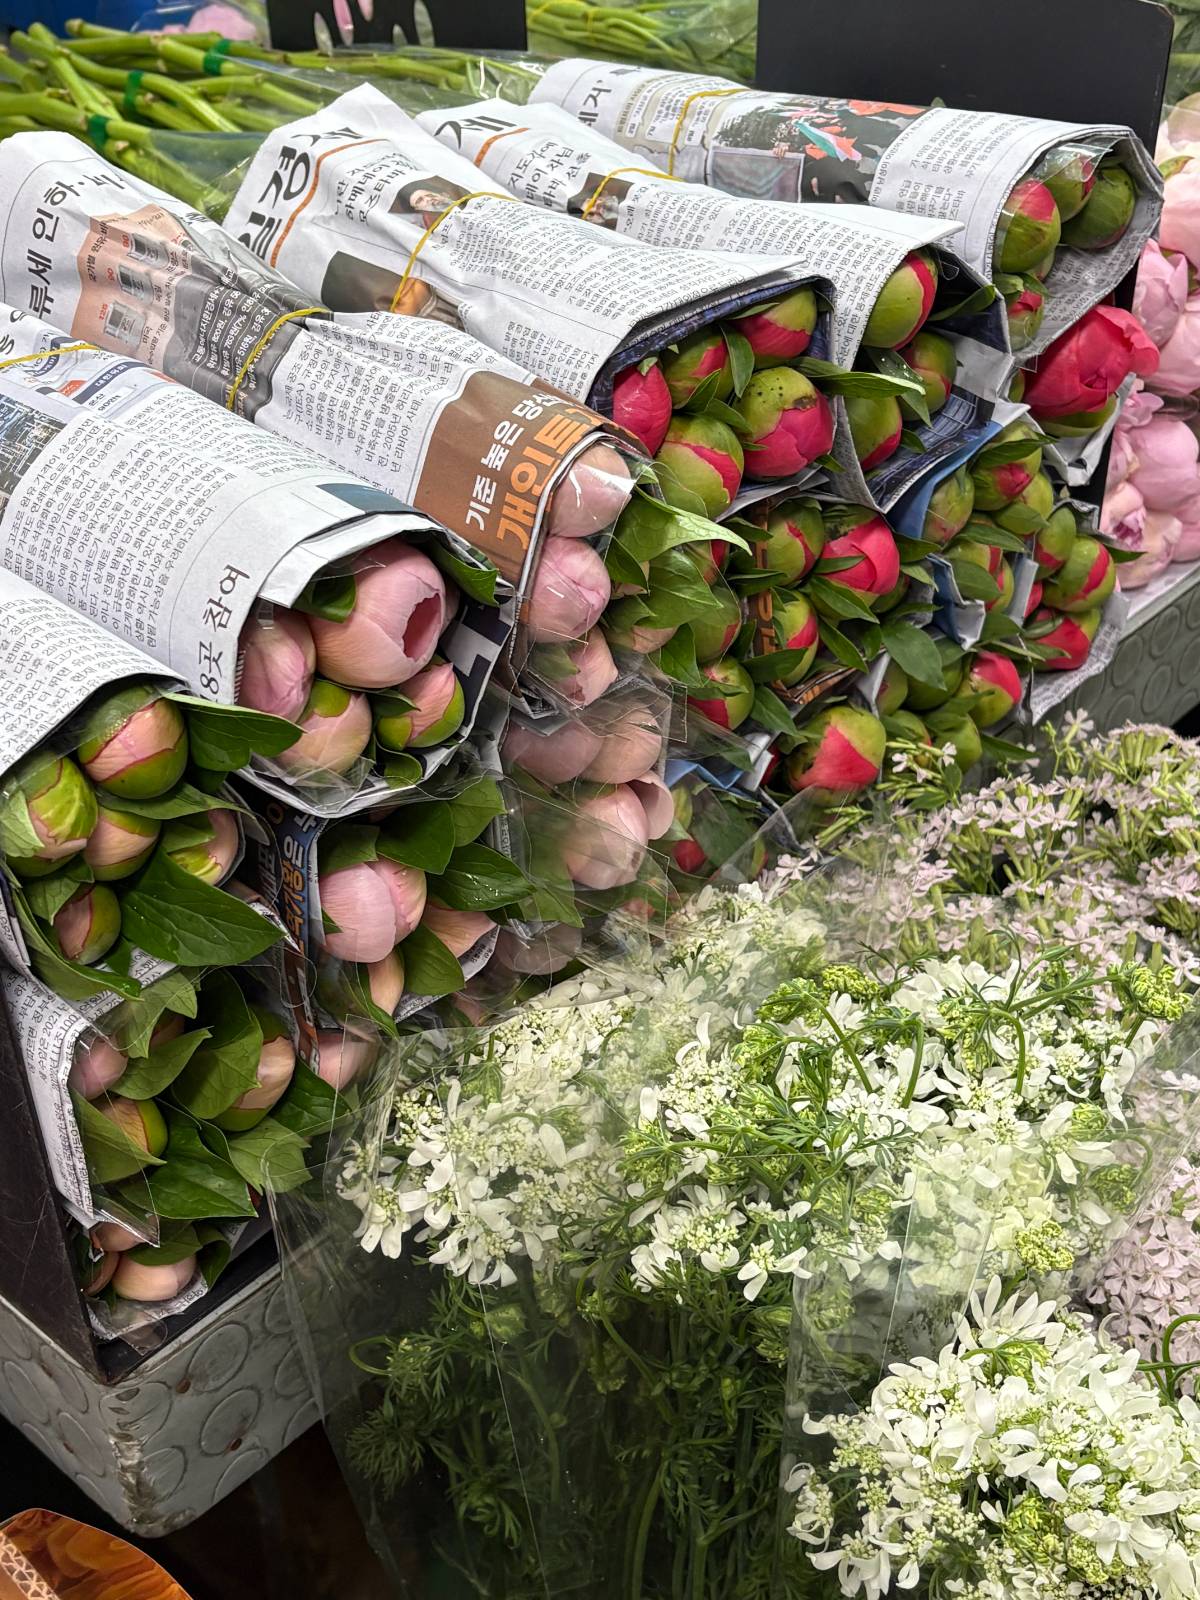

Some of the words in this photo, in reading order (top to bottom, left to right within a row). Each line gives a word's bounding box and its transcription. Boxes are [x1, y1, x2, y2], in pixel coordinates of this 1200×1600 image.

[394, 424, 411, 459] 리비아
[480, 420, 524, 471] 높은
[20, 486, 37, 507] 원유
[34, 454, 60, 485] 가격이
[53, 476, 72, 496] 제품
[466, 475, 497, 531] 기준
[18, 516, 35, 551] 가격도
[107, 509, 132, 546] 2022년
[38, 538, 52, 561] 공급
[136, 560, 147, 572] 바
[56, 562, 68, 587] 이에
[103, 572, 116, 596] 전쟁
[202, 564, 250, 632] 참여
[110, 617, 120, 629] 이
